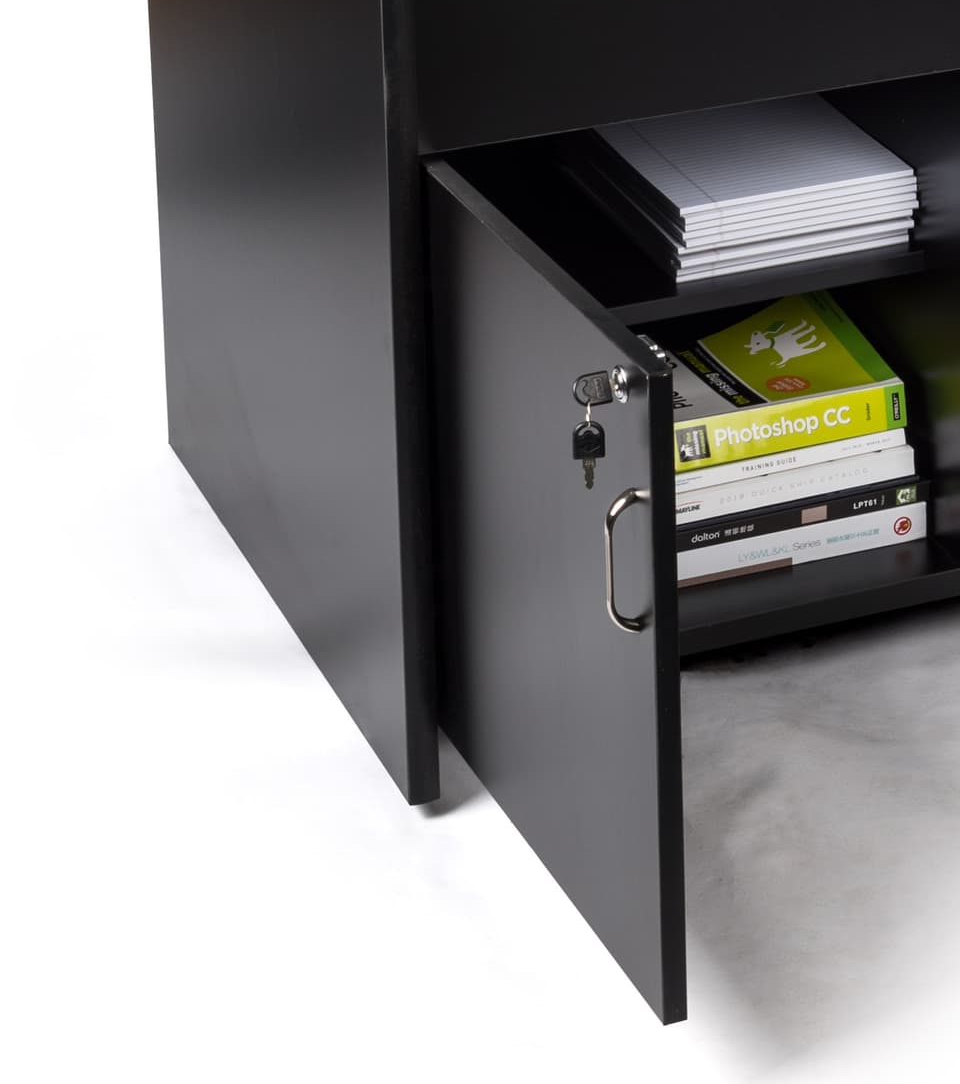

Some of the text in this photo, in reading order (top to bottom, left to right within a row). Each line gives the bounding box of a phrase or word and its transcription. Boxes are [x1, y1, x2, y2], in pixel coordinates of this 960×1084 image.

[714, 414, 819, 448] Photoshop
[823, 405, 852, 427] CC
[741, 456, 797, 473] TRAINING GUIDE
[751, 485, 784, 498] QUICK
[853, 498, 878, 510] LPT61
[691, 531, 720, 544] dalton
[791, 538, 823, 552] Series
